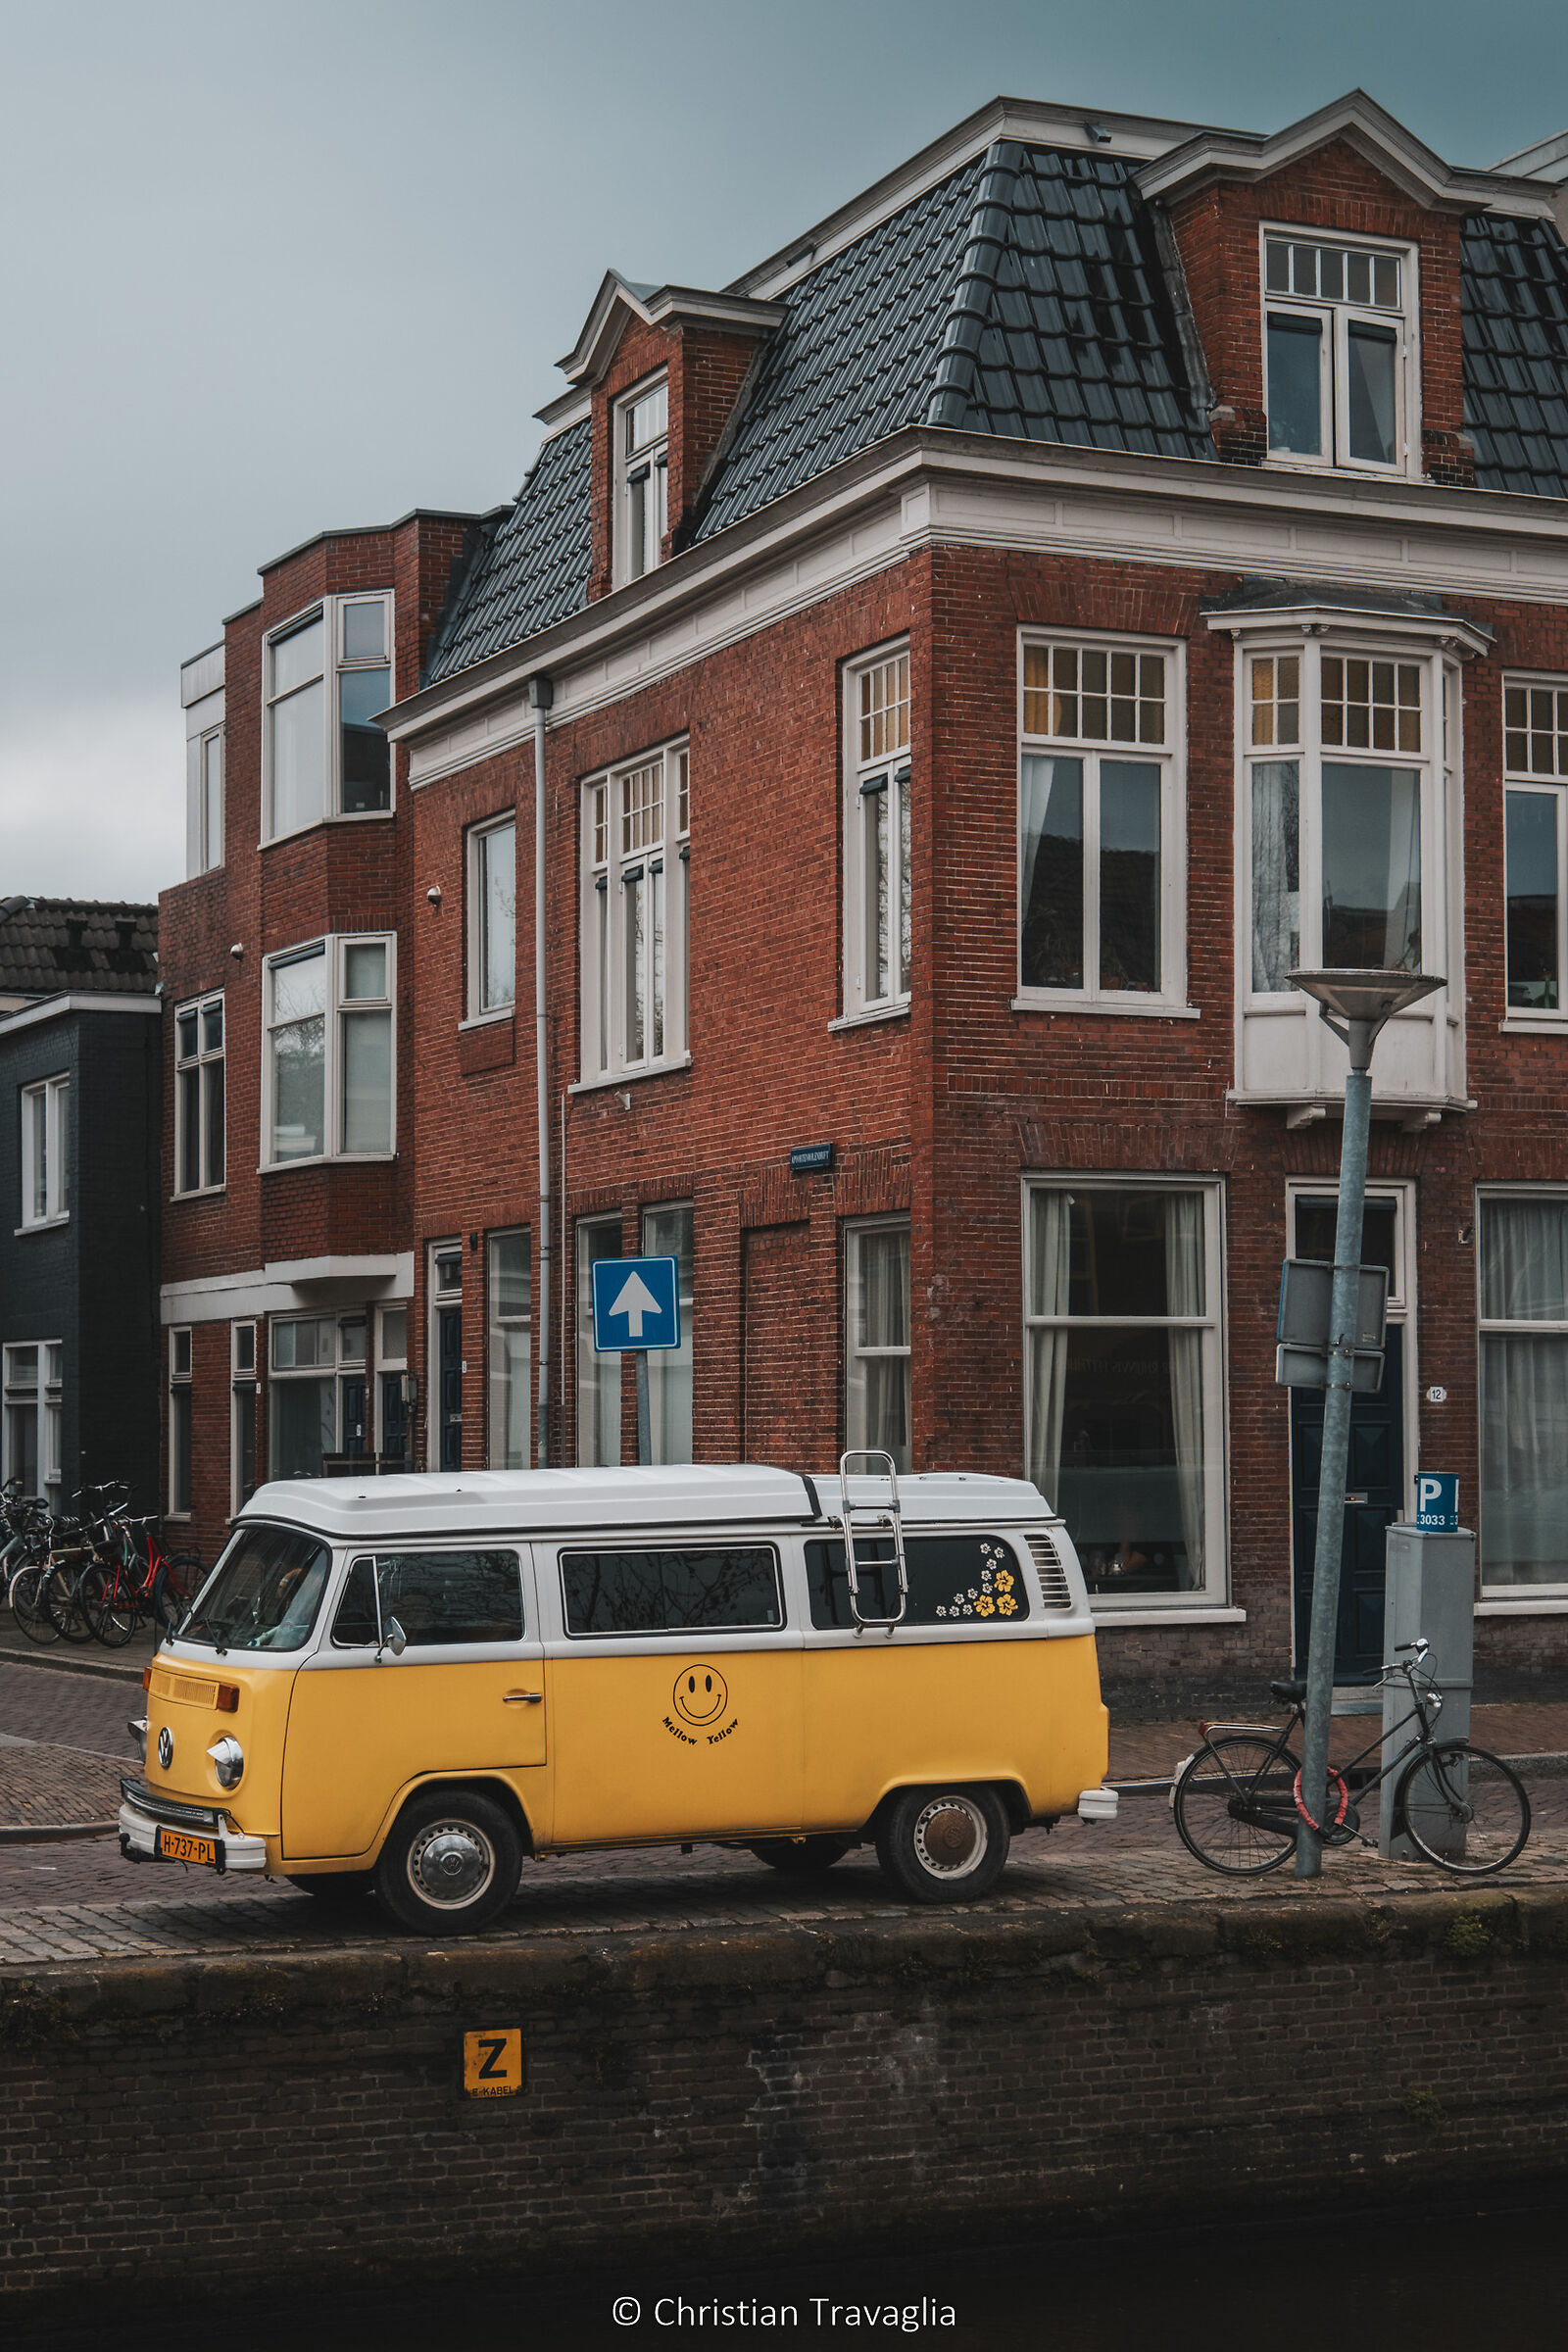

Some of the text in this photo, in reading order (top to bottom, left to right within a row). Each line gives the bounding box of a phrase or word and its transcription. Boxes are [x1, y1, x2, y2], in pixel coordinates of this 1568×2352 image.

[1432, 1389, 1442, 1399] 12
[1420, 1478, 1443, 1512] P
[1420, 1514, 1446, 1526] 3033
[662, 1717, 738, 1745] Mellow Yellow
[478, 2038, 508, 2080] Z
